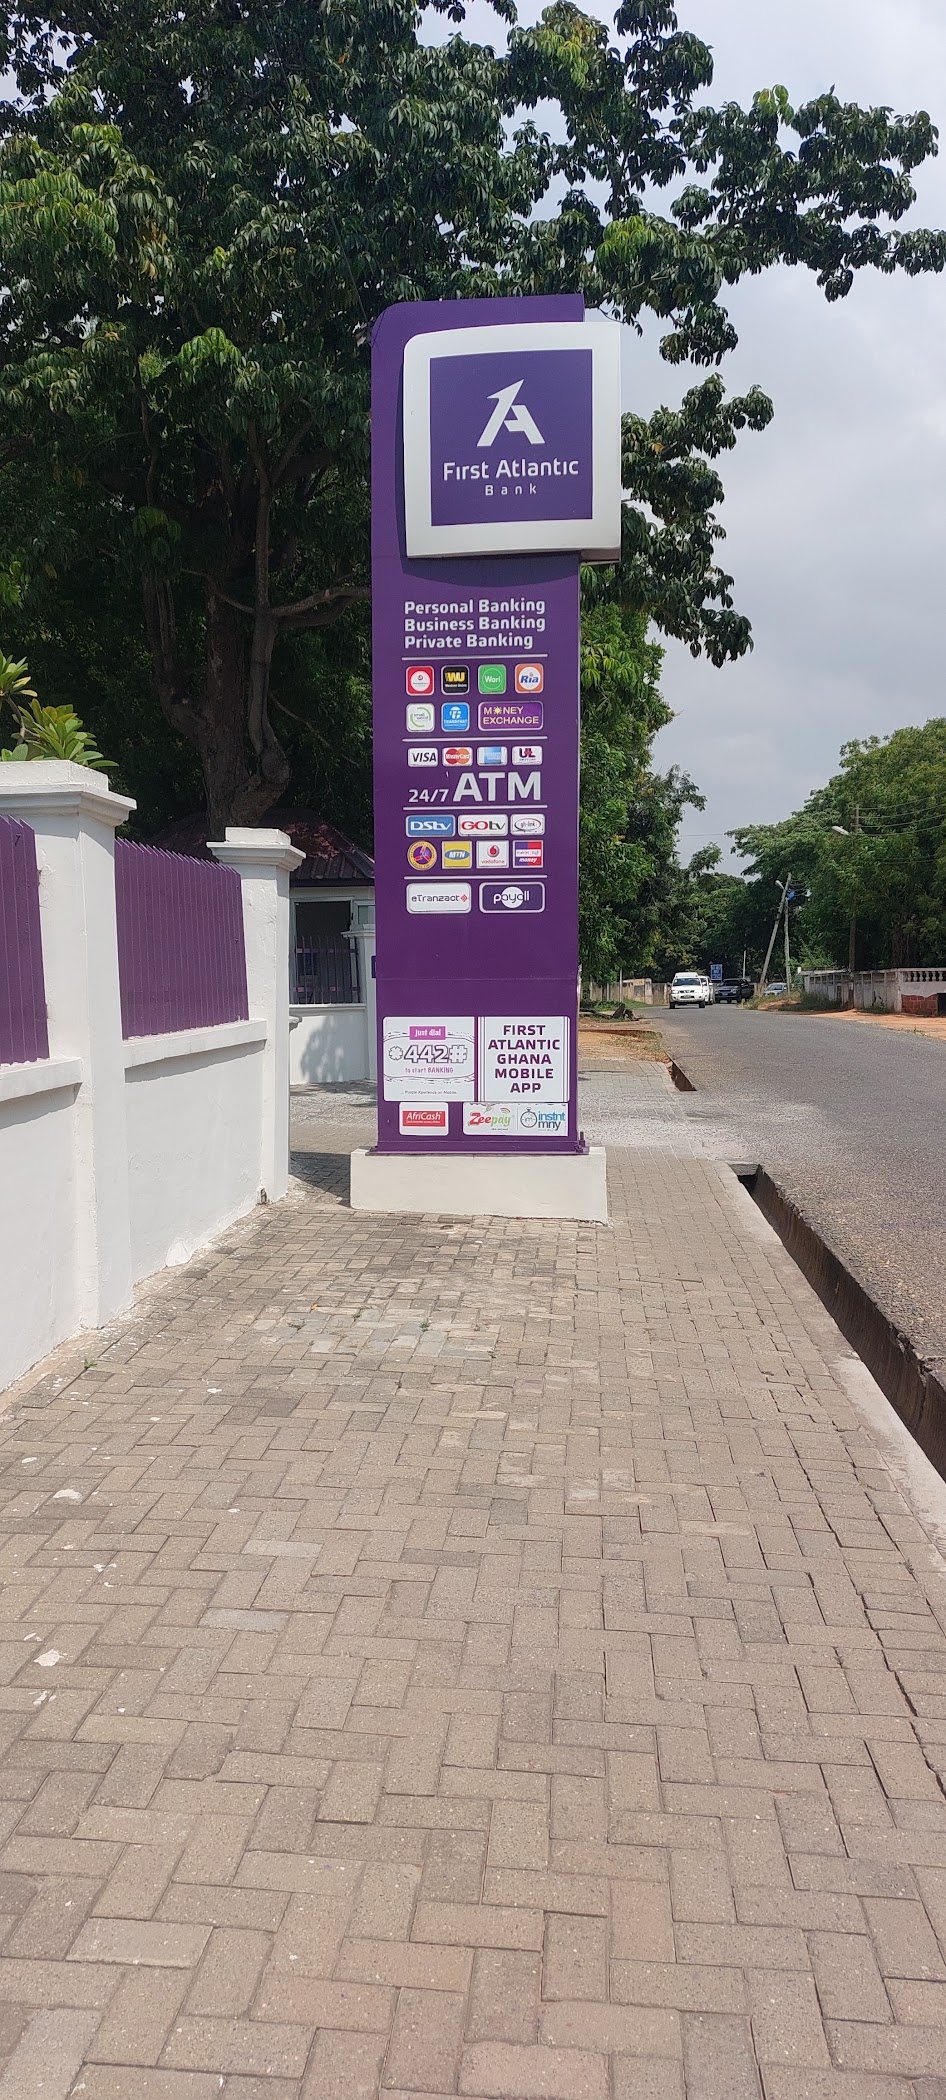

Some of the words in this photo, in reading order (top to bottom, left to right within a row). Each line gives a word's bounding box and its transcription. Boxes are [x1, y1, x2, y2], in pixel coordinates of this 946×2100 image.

[443, 459, 490, 481] First
[496, 457, 579, 478] Atlantic
[485, 483, 537, 496] Bank
[404, 599, 474, 614] Personal
[479, 597, 546, 614] Banking
[404, 617, 475, 632] Business
[479, 614, 546, 632] Banking
[404, 634, 462, 649] Private
[466, 632, 533, 649] Banking
[520, 671, 539, 683] Ria
[483, 716, 539, 725] EXCHANGE
[412, 752, 437, 763] VISA
[408, 788, 449, 803] 24/7
[452, 771, 541, 802] ATM
[410, 821, 451, 831] DStv
[461, 820, 506, 831] GOtv
[448, 851, 466, 859] MTN
[411, 894, 460, 903] eTranzact
[493, 890, 530, 905] payall
[414, 1028, 428, 1038] just
[503, 1024, 546, 1036] FIRST
[487, 1039, 560, 1050] ATLANTIC
[497, 1053, 552, 1065] GHANA
[427, 1066, 454, 1074] BANKING
[494, 1068, 554, 1079] MOBILE
[510, 1082, 541, 1093] APP
[406, 1111, 441, 1121] AfriCash
[468, 1112, 511, 1127] Zeepay
[538, 1111, 566, 1121] instnt
[538, 1121, 561, 1131] mny
